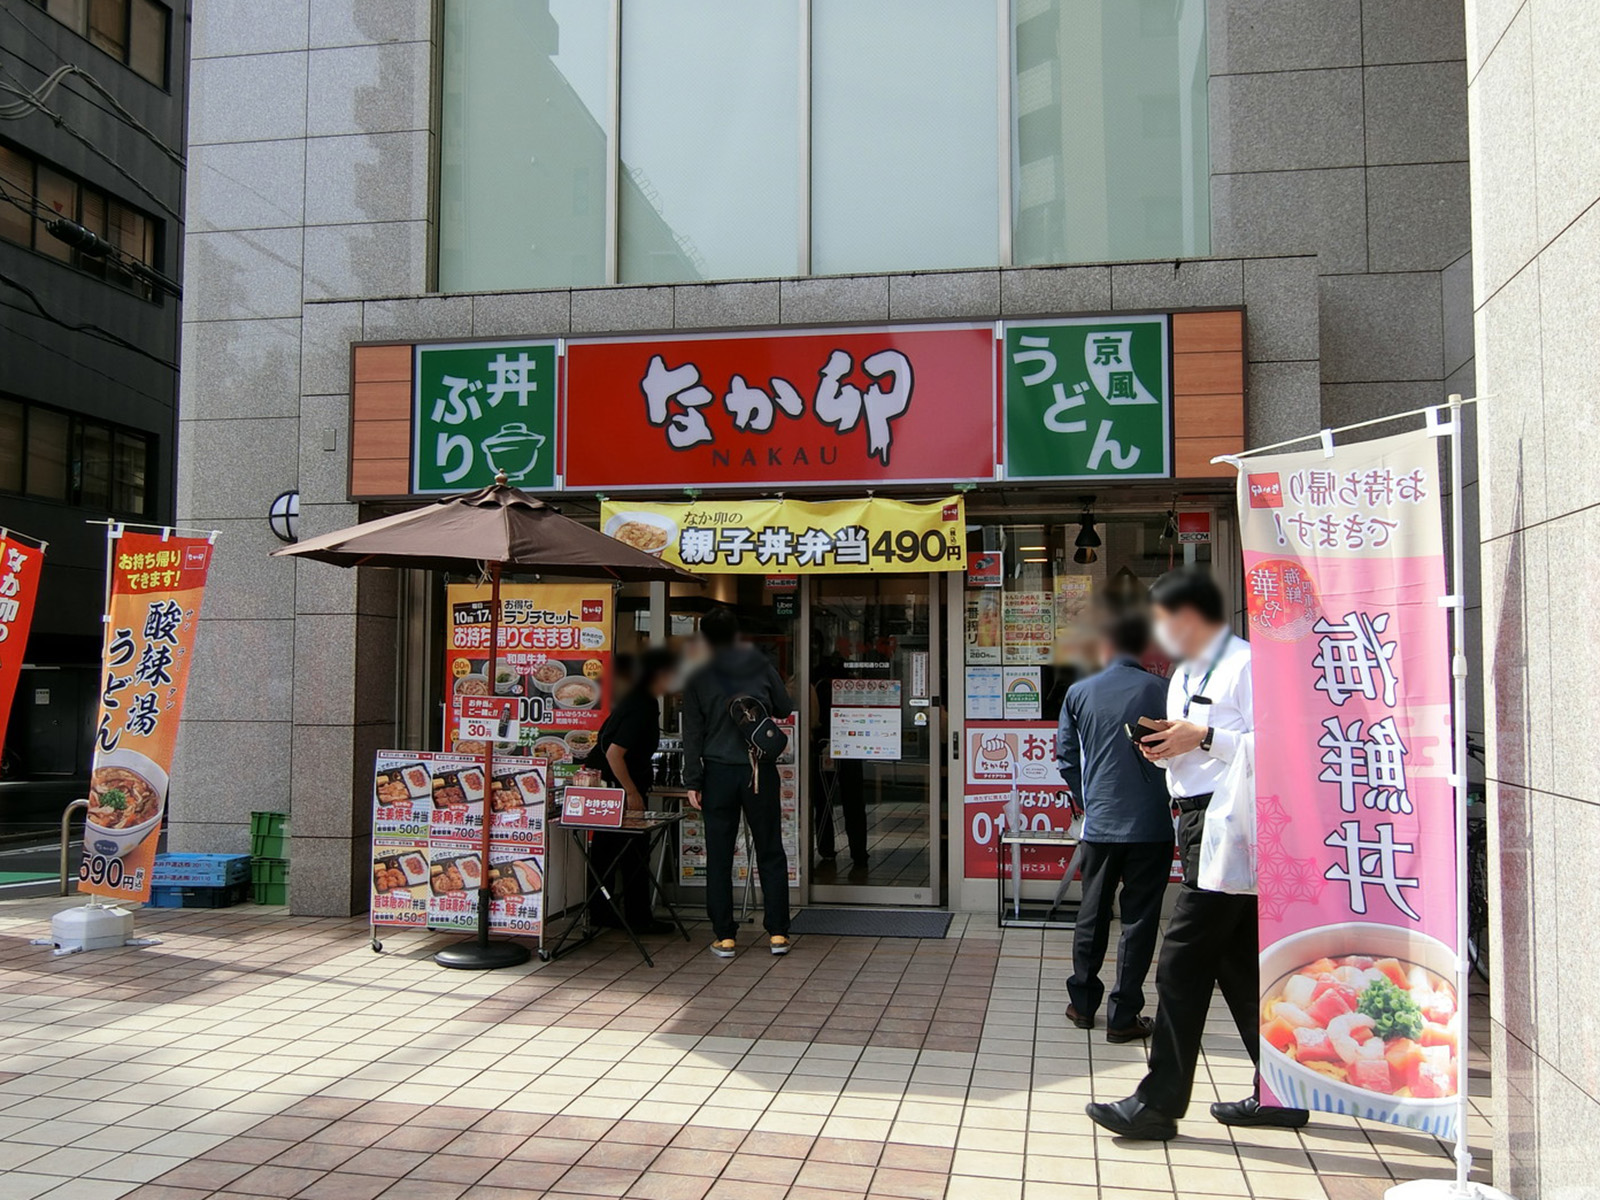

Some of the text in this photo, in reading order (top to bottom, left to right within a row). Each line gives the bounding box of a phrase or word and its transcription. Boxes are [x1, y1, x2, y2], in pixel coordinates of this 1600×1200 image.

[1093, 336, 1136, 400] 京風
[641, 349, 914, 467] なか卯
[1012, 335, 1141, 471] うどん
[712, 446, 837, 467] NAKAU
[683, 511, 743, 526] なか卯の
[1180, 532, 1209, 541] SECOM
[680, 526, 869, 566] 親子丼弁当
[118, 550, 181, 570] お持ち帰り
[127, 570, 181, 589] できます!
[504, 610, 579, 625] ランチセット
[507, 653, 547, 664] 和風牛丼
[125, 599, 182, 737] 酸辣湯
[515, 665, 538, 675] セット
[97, 628, 137, 753] うどん
[520, 698, 554, 724] 00円
[520, 727, 539, 737] 子丼
[981, 761, 1009, 771] なか卯
[586, 799, 621, 808] お持ち帰り
[589, 808, 615, 816] コーナー
[377, 807, 429, 822] 生姜焼き弁当
[432, 810, 484, 826] 豚角煮弁当
[80, 851, 134, 890] 590円
